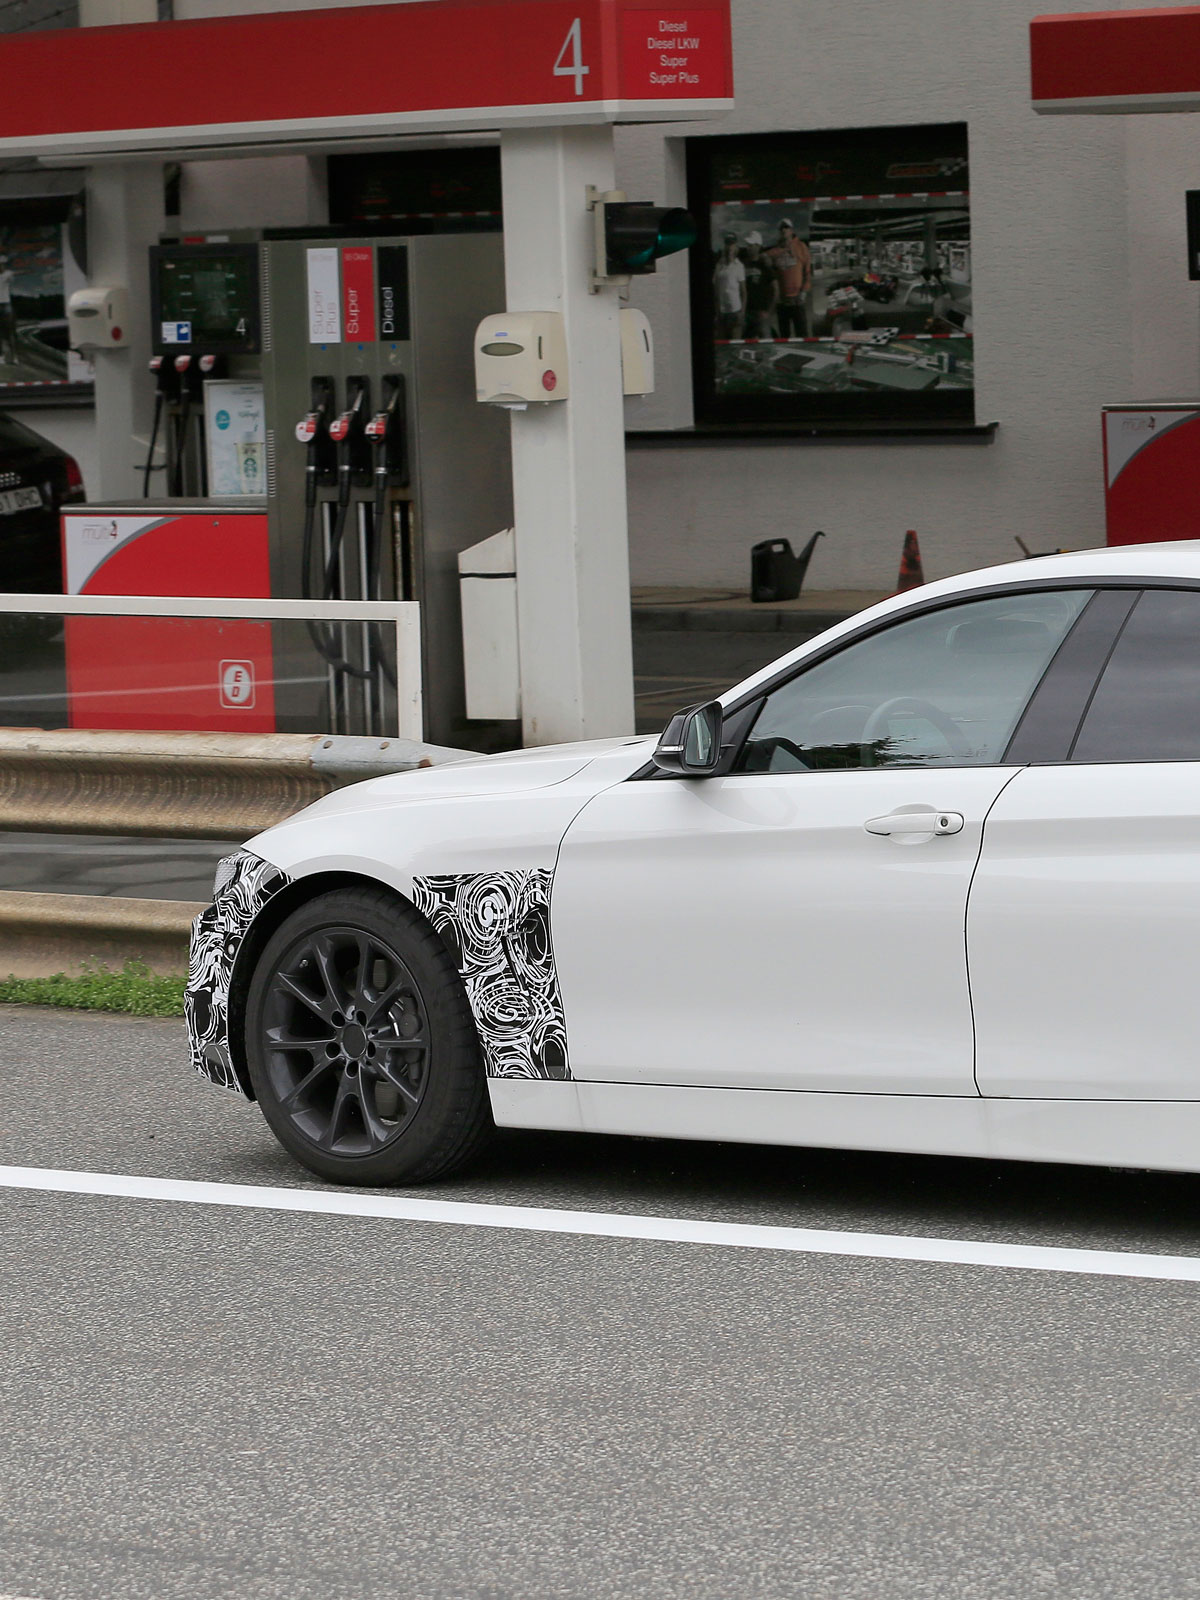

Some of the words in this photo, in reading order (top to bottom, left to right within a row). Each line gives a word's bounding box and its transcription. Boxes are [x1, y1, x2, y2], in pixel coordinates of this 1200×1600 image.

[659, 20, 687, 32] Diesel
[647, 37, 675, 49] Diesel
[677, 38, 700, 49] LKW
[553, 17, 590, 96] 4
[660, 55, 687, 68] Super
[649, 72, 676, 85] Super
[679, 72, 699, 84] Plus
[346, 287, 360, 334] Super
[381, 286, 395, 334] Diesel
[236, 318, 247, 336] 4
